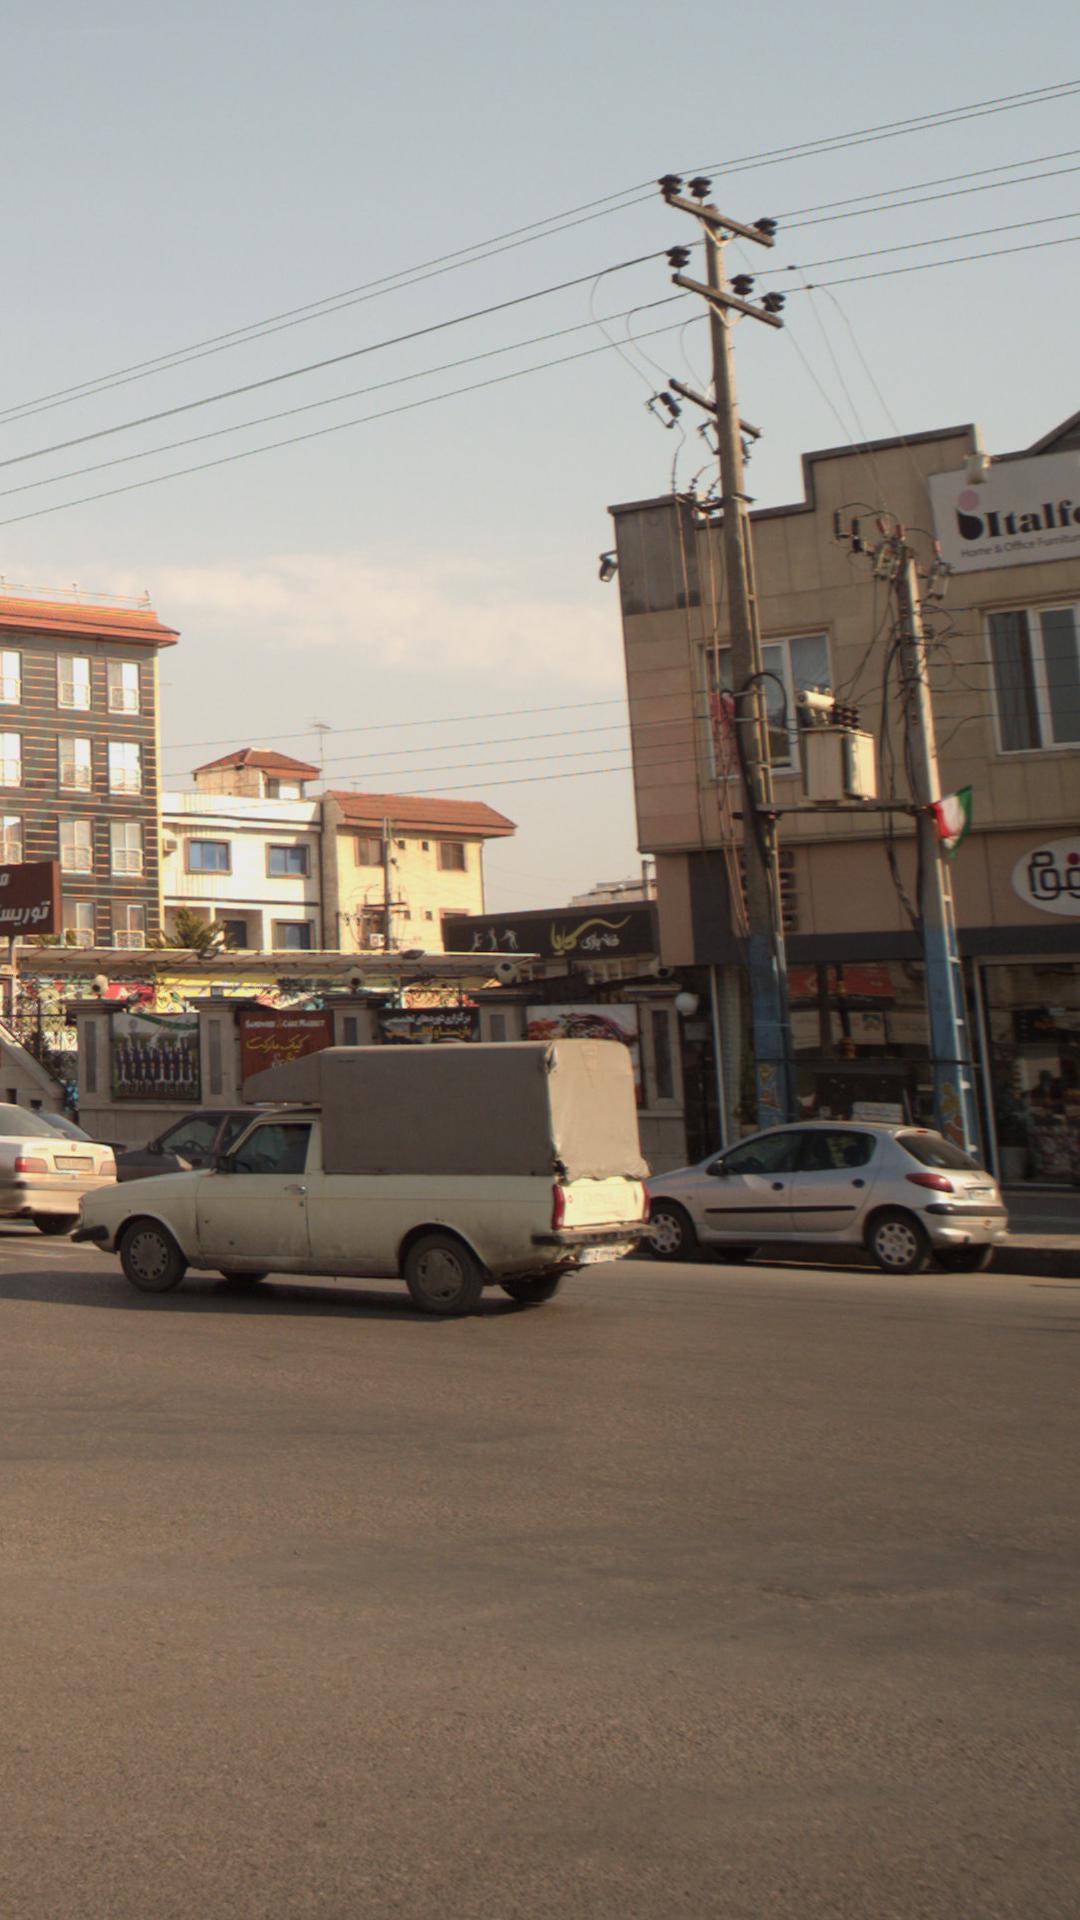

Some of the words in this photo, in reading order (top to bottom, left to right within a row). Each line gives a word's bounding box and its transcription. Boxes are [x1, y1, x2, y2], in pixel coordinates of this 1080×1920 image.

[961, 547, 992, 558] Home
[994, 544, 1003, 553] &
[1004, 540, 1035, 552] Office
[0, 900, 51, 927] توریس
